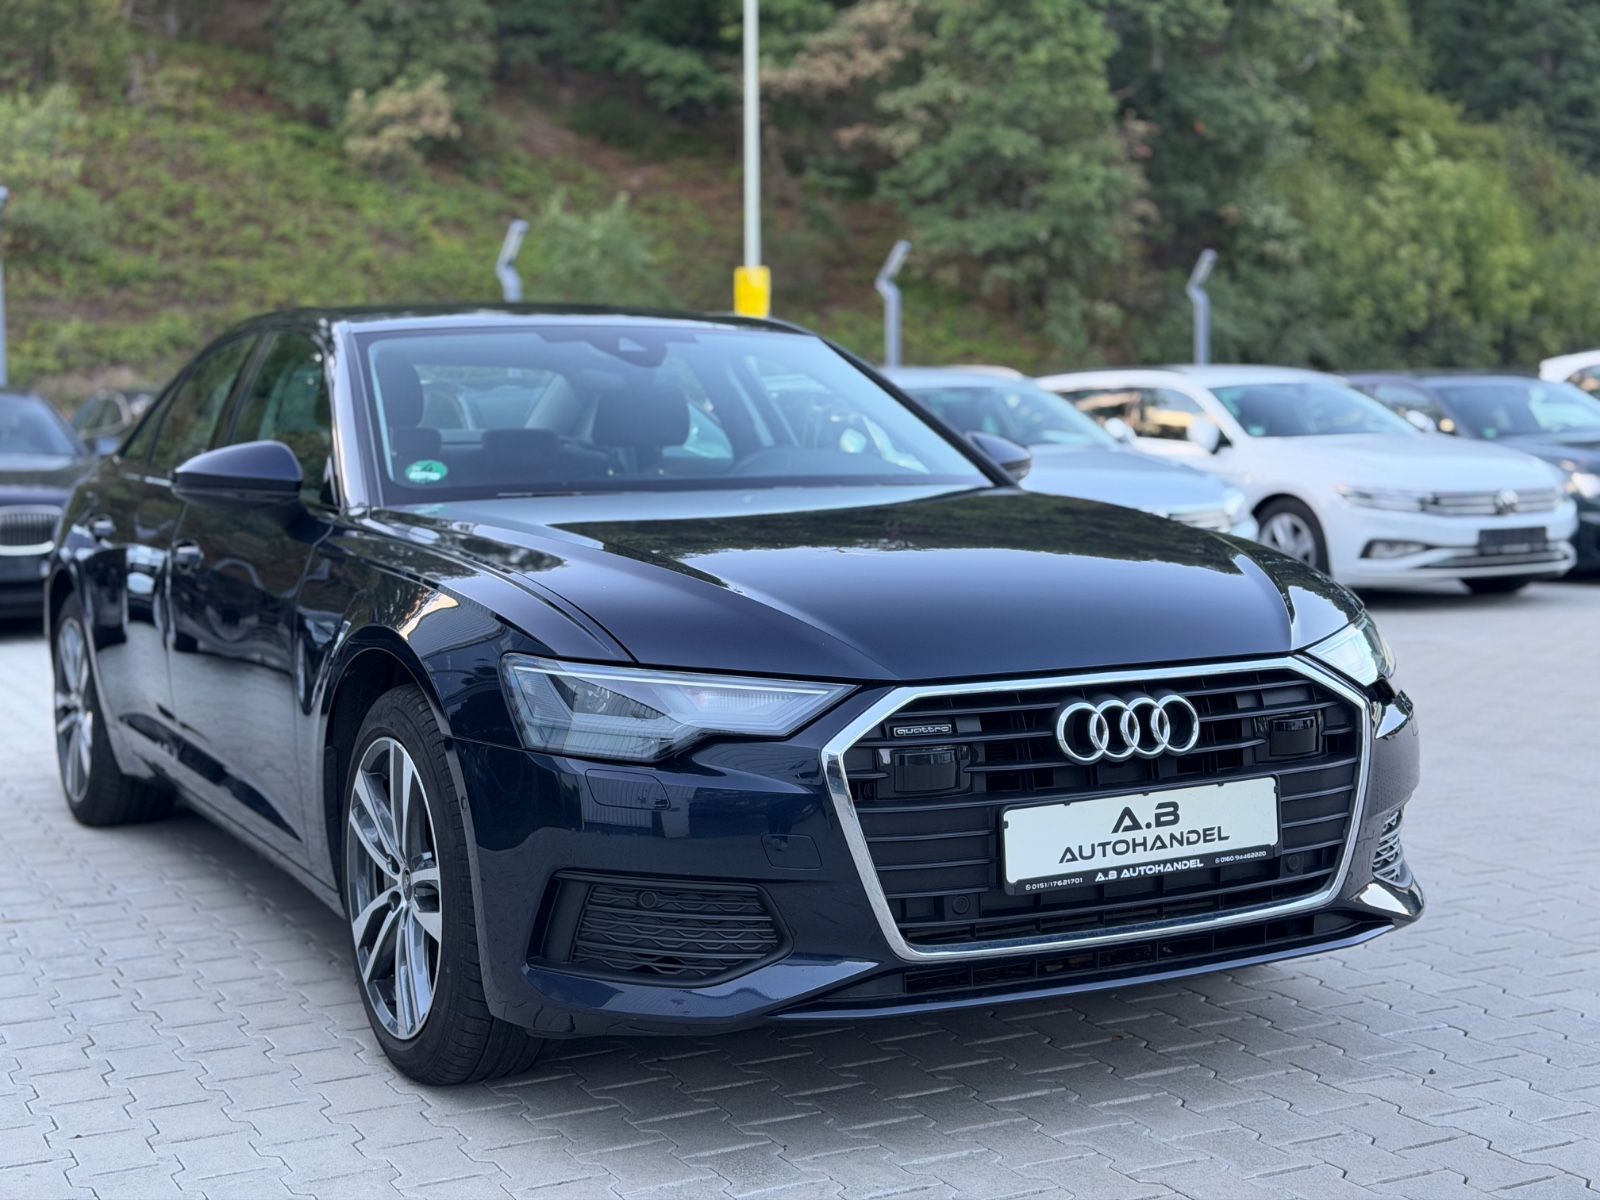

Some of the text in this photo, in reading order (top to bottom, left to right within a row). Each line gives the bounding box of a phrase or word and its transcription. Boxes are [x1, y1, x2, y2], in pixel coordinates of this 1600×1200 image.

[896, 725, 950, 736] quattro
[1111, 801, 1180, 834] A.B
[1058, 826, 1230, 864] AUTOHANDEL
[1095, 859, 1204, 882] A.B AUTOHANDEL
